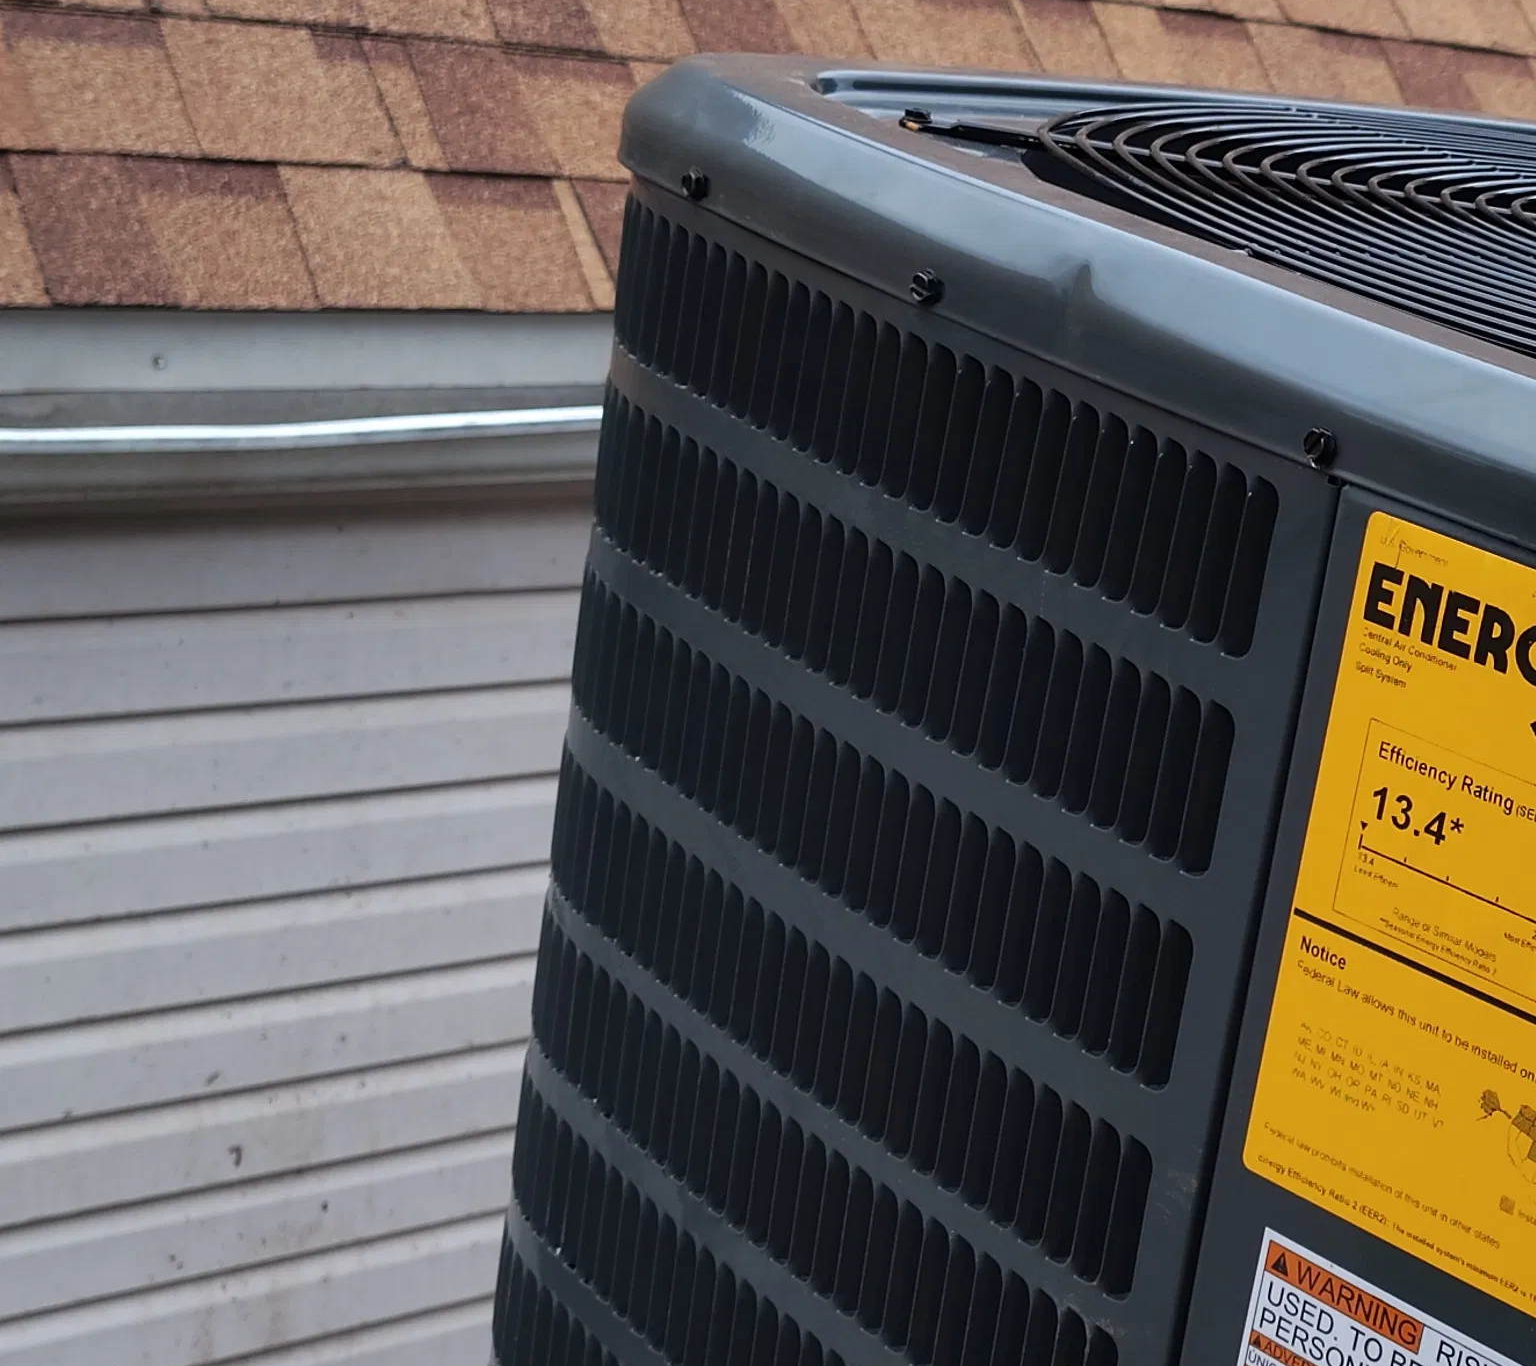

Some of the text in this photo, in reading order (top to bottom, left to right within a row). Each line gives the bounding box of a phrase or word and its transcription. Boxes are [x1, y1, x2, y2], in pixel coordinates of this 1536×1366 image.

[1378, 740, 1458, 791] Efficiency
[1460, 774, 1515, 816] Rating
[1300, 935, 1347, 971] Notice
[1337, 979, 1361, 999] Law
[1361, 993, 1395, 1017] allows
[1397, 1008, 1417, 1026] this
[1419, 1021, 1440, 1037] unit
[1441, 1028, 1453, 1044] to
[1454, 1035, 1470, 1051] be
[1471, 1044, 1518, 1074] installed
[1267, 1280, 1338, 1341] USED.
[1350, 1325, 1383, 1363] TO
[1297, 1260, 1418, 1346] WARNING
